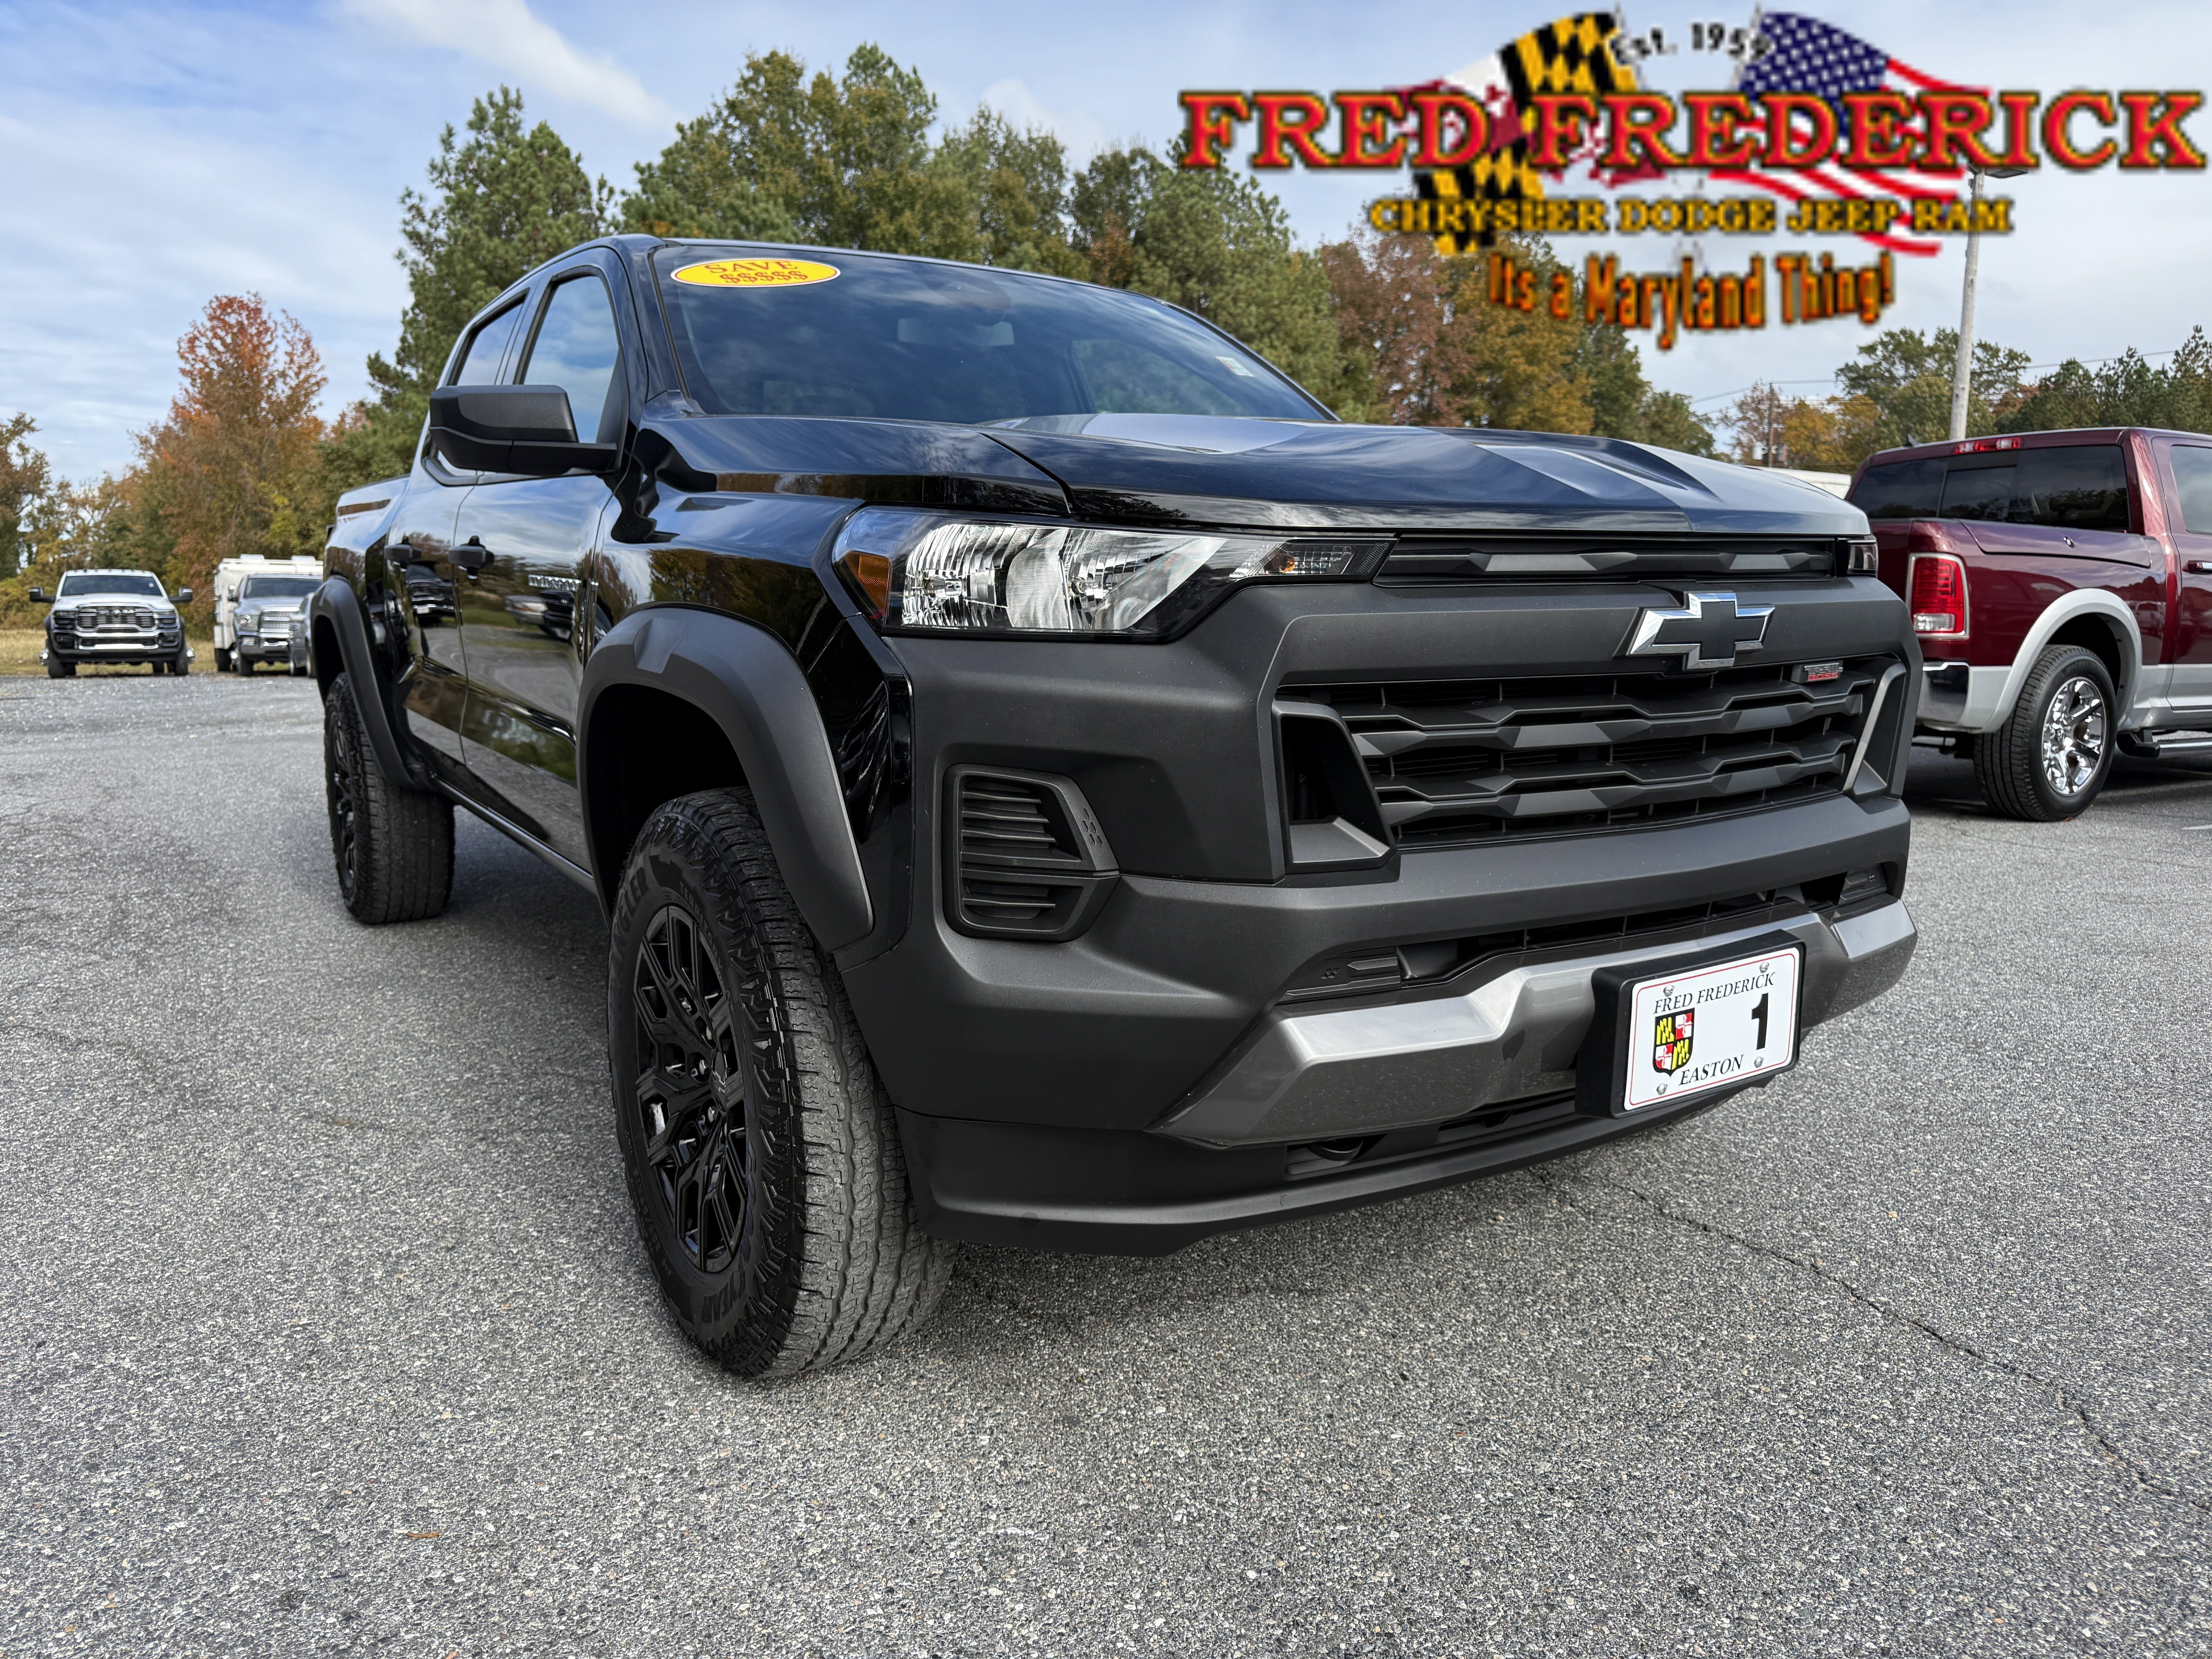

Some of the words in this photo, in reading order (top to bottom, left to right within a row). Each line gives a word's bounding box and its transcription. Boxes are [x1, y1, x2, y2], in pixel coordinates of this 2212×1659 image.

[704, 261, 798, 273] SAVE
[719, 271, 809, 284] $$$$$
[1808, 672, 1839, 681] BOSS
[1653, 992, 1693, 1015] FRED
[1696, 972, 1776, 1005] FREDERICK
[1751, 992, 1769, 1051] 1
[1678, 1054, 1744, 1086] EASTON
